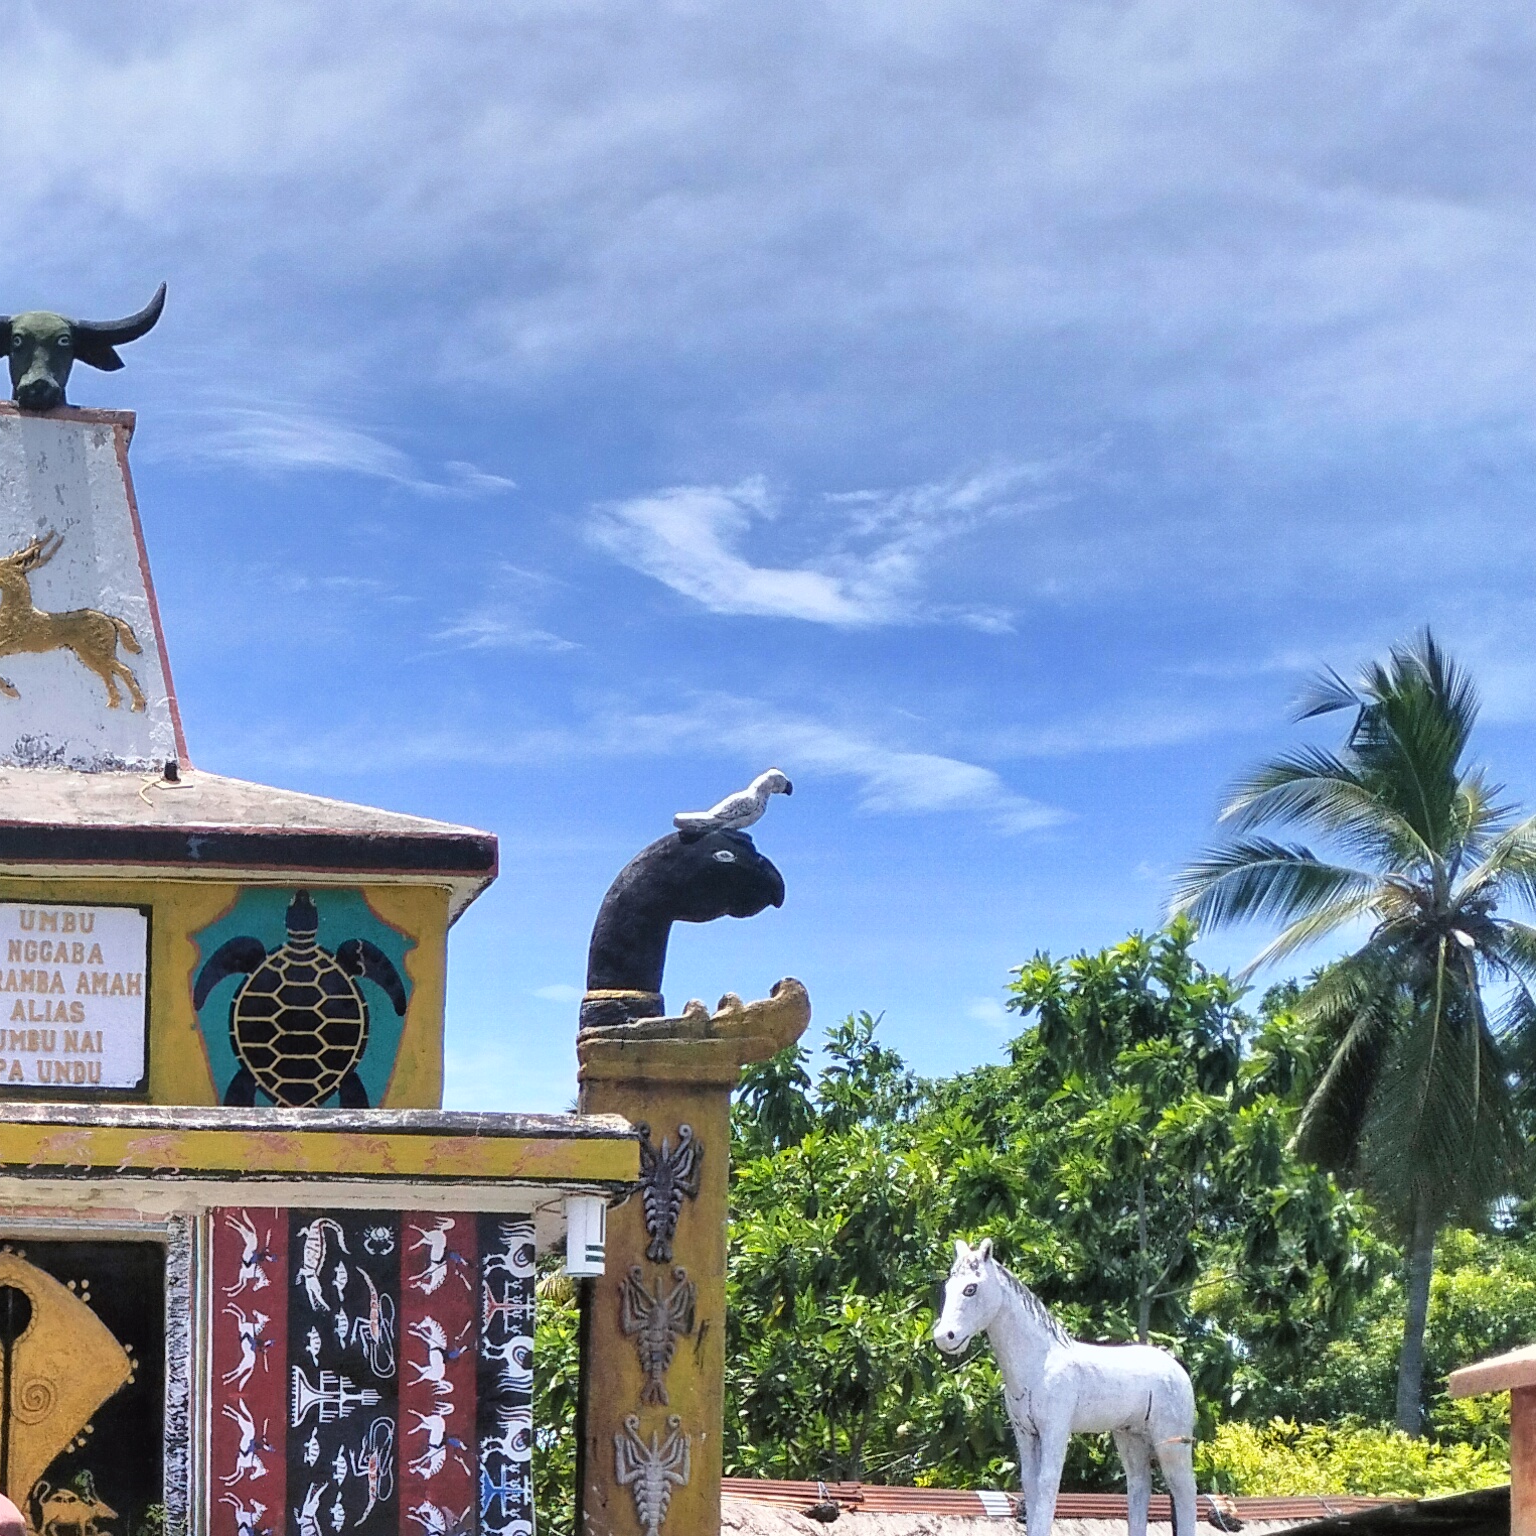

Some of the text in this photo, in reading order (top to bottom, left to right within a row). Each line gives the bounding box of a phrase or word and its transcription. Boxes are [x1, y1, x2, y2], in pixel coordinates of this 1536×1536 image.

[19, 909, 96, 934] UMBU
[7, 938, 104, 965] NGGABA
[75, 970, 143, 997] AMAH
[9, 998, 86, 1023] ALIAS
[64, 1029, 104, 1054] NAI
[36, 1059, 103, 1084] UNDU
